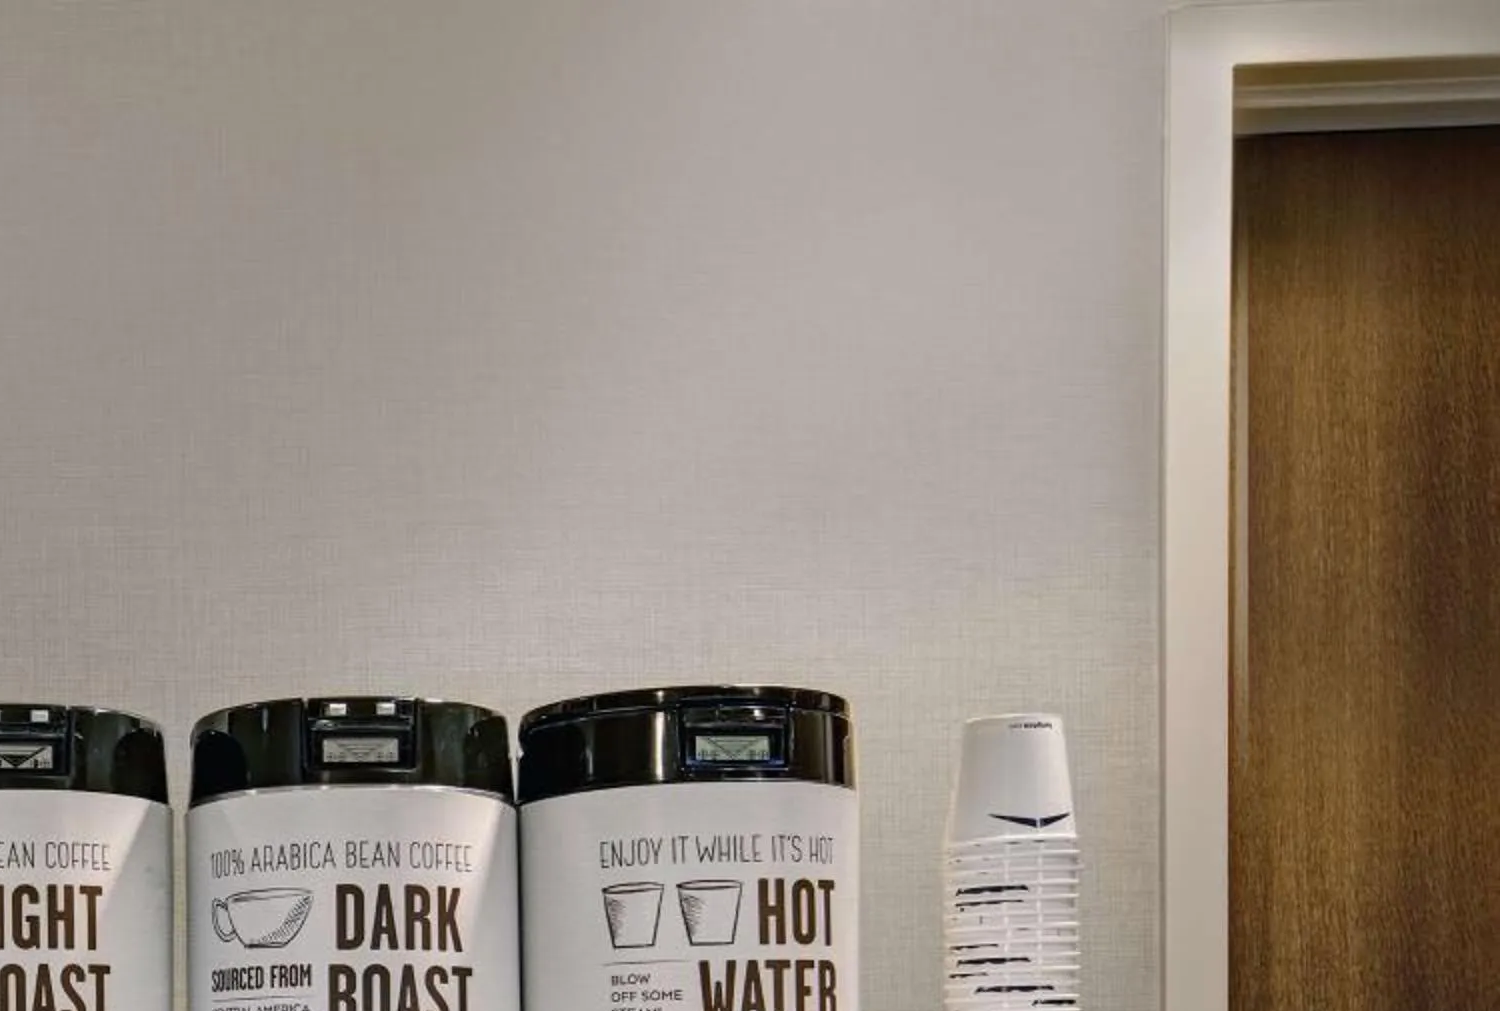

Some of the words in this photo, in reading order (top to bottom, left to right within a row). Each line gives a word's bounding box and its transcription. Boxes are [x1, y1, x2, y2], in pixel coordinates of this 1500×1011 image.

[44, 841, 112, 872] COFFEE
[211, 848, 245, 879] 100%
[251, 841, 337, 872] ARABICA
[344, 840, 401, 870] BEAN
[409, 841, 473, 873] COFFEE
[600, 837, 663, 869] ENJOY
[671, 835, 689, 865] IT
[695, 834, 763, 863] WHILE
[771, 834, 802, 864] IT'S
[808, 836, 834, 865] HOT
[335, 883, 464, 953] DARK
[757, 878, 835, 947] HOT
[211, 965, 265, 993] SOURCED
[270, 963, 312, 989] FROM
[611, 973, 651, 987] BLOW
[611, 991, 637, 1003] OFF
[641, 989, 684, 1002] SOME
